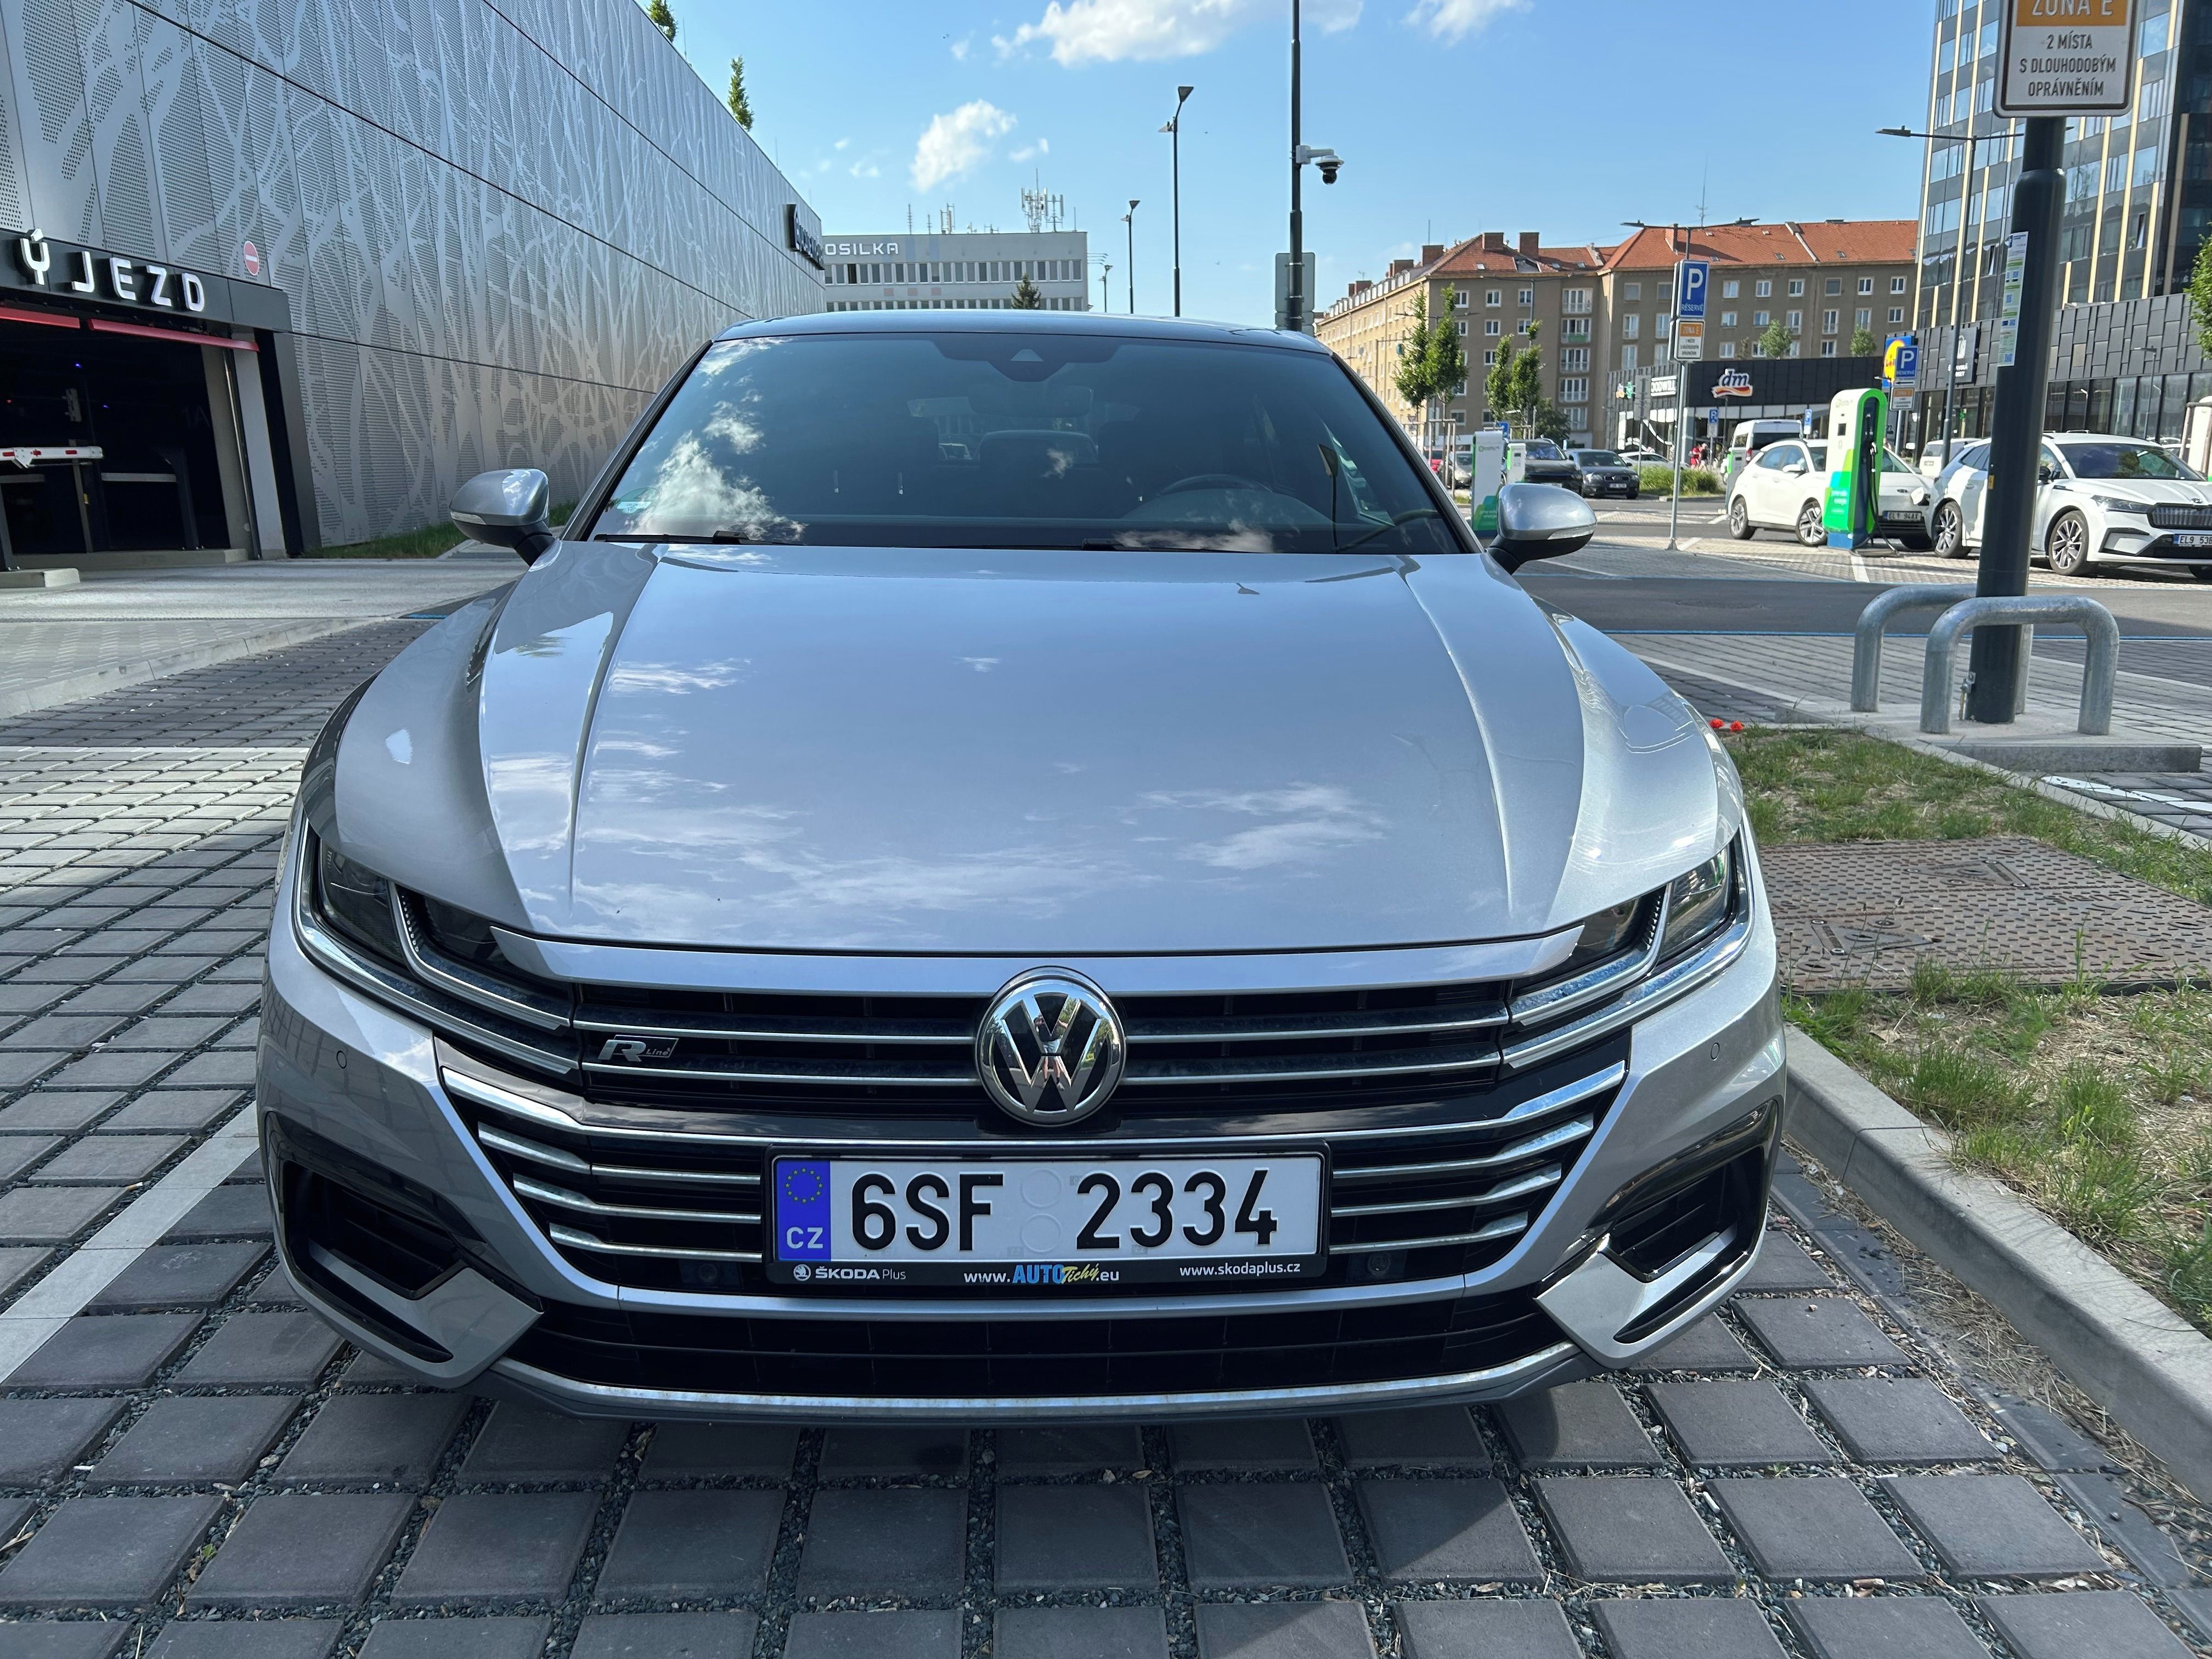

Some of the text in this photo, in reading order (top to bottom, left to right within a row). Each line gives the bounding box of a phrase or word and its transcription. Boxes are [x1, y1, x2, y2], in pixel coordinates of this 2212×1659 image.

[2046, 30, 2093, 49] 2 MÍSTA
[2019, 54, 2117, 73] S DLOUHODOBÝM
[2028, 77, 2104, 97] OPRÁVNĚNÍM
[825, 242, 899, 255] OSILKA
[1686, 268, 1703, 300] P
[1900, 350, 1915, 369] P
[1721, 370, 1748, 386] dm
[2180, 535, 2194, 544] EL9
[598, 1039, 646, 1062] R
[851, 1169, 1278, 1251] 6SF 2334
[786, 1226, 824, 1249] CZ
[815, 1266, 906, 1280] ŠKODA Plus
[1180, 1261, 1301, 1277] www.skodaplus.cz
